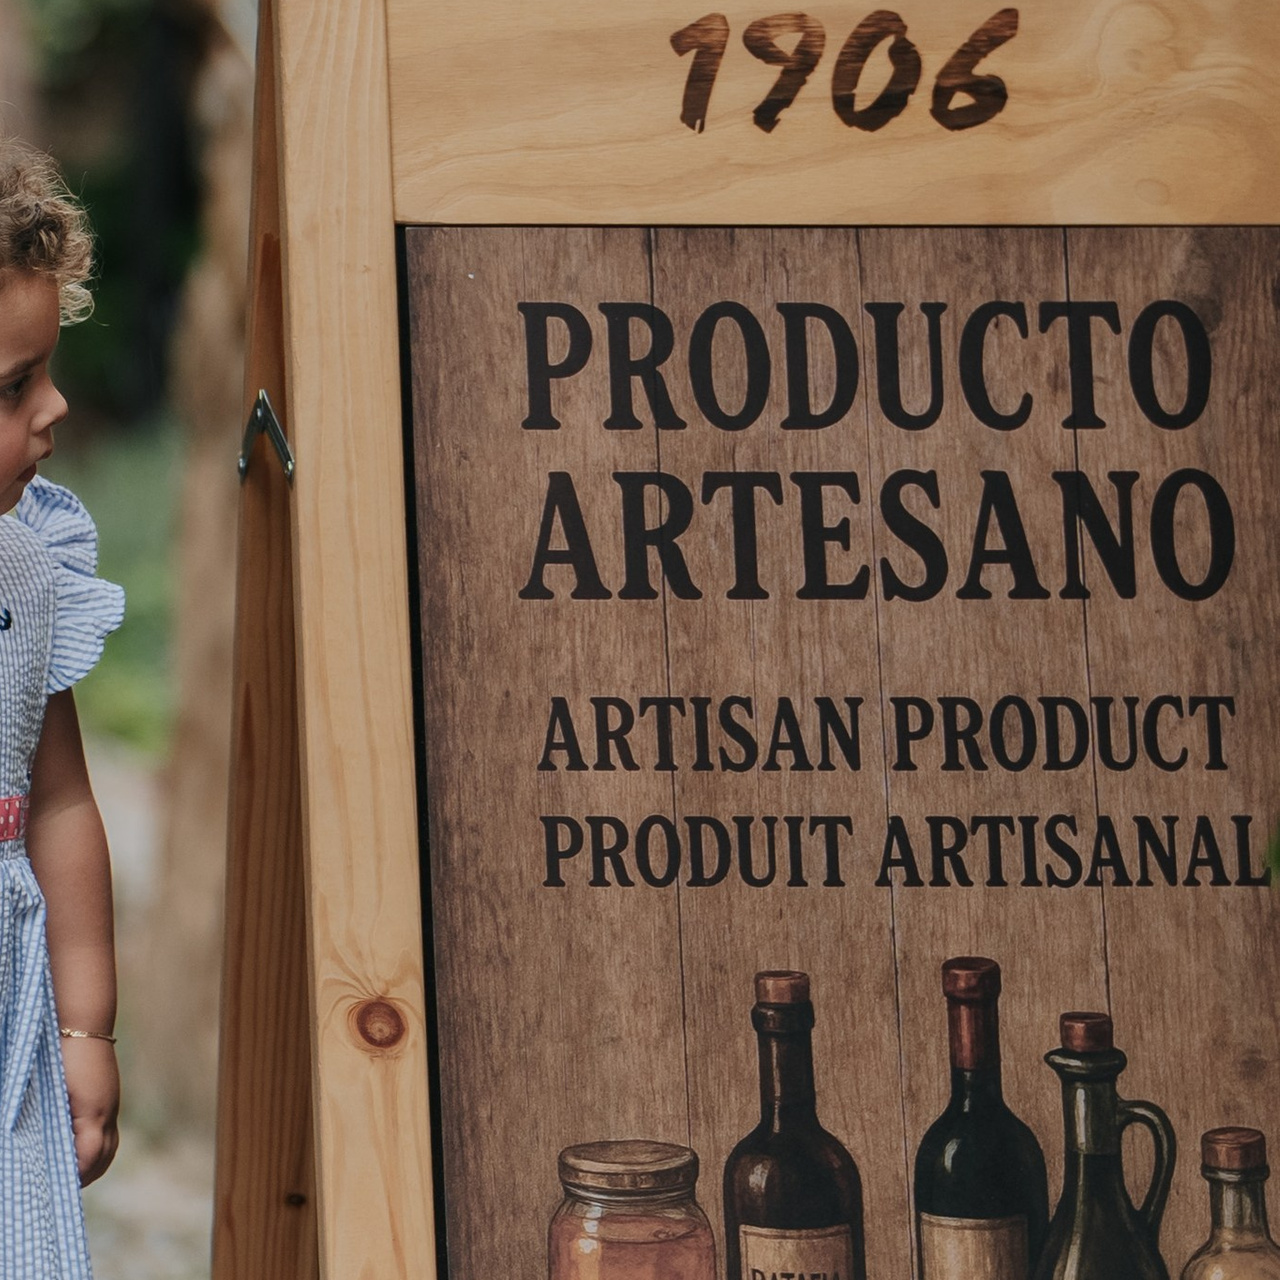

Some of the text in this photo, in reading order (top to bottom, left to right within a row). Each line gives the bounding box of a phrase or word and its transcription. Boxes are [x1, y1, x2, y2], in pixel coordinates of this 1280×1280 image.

[669, 7, 1020, 134] 1906
[517, 300, 1213, 433] PRODUCTO
[518, 467, 1237, 603] ARTESANO
[537, 693, 1236, 773] ARTISAN PRODUCT
[539, 813, 1272, 889] PRODUIT ARTISANAL
